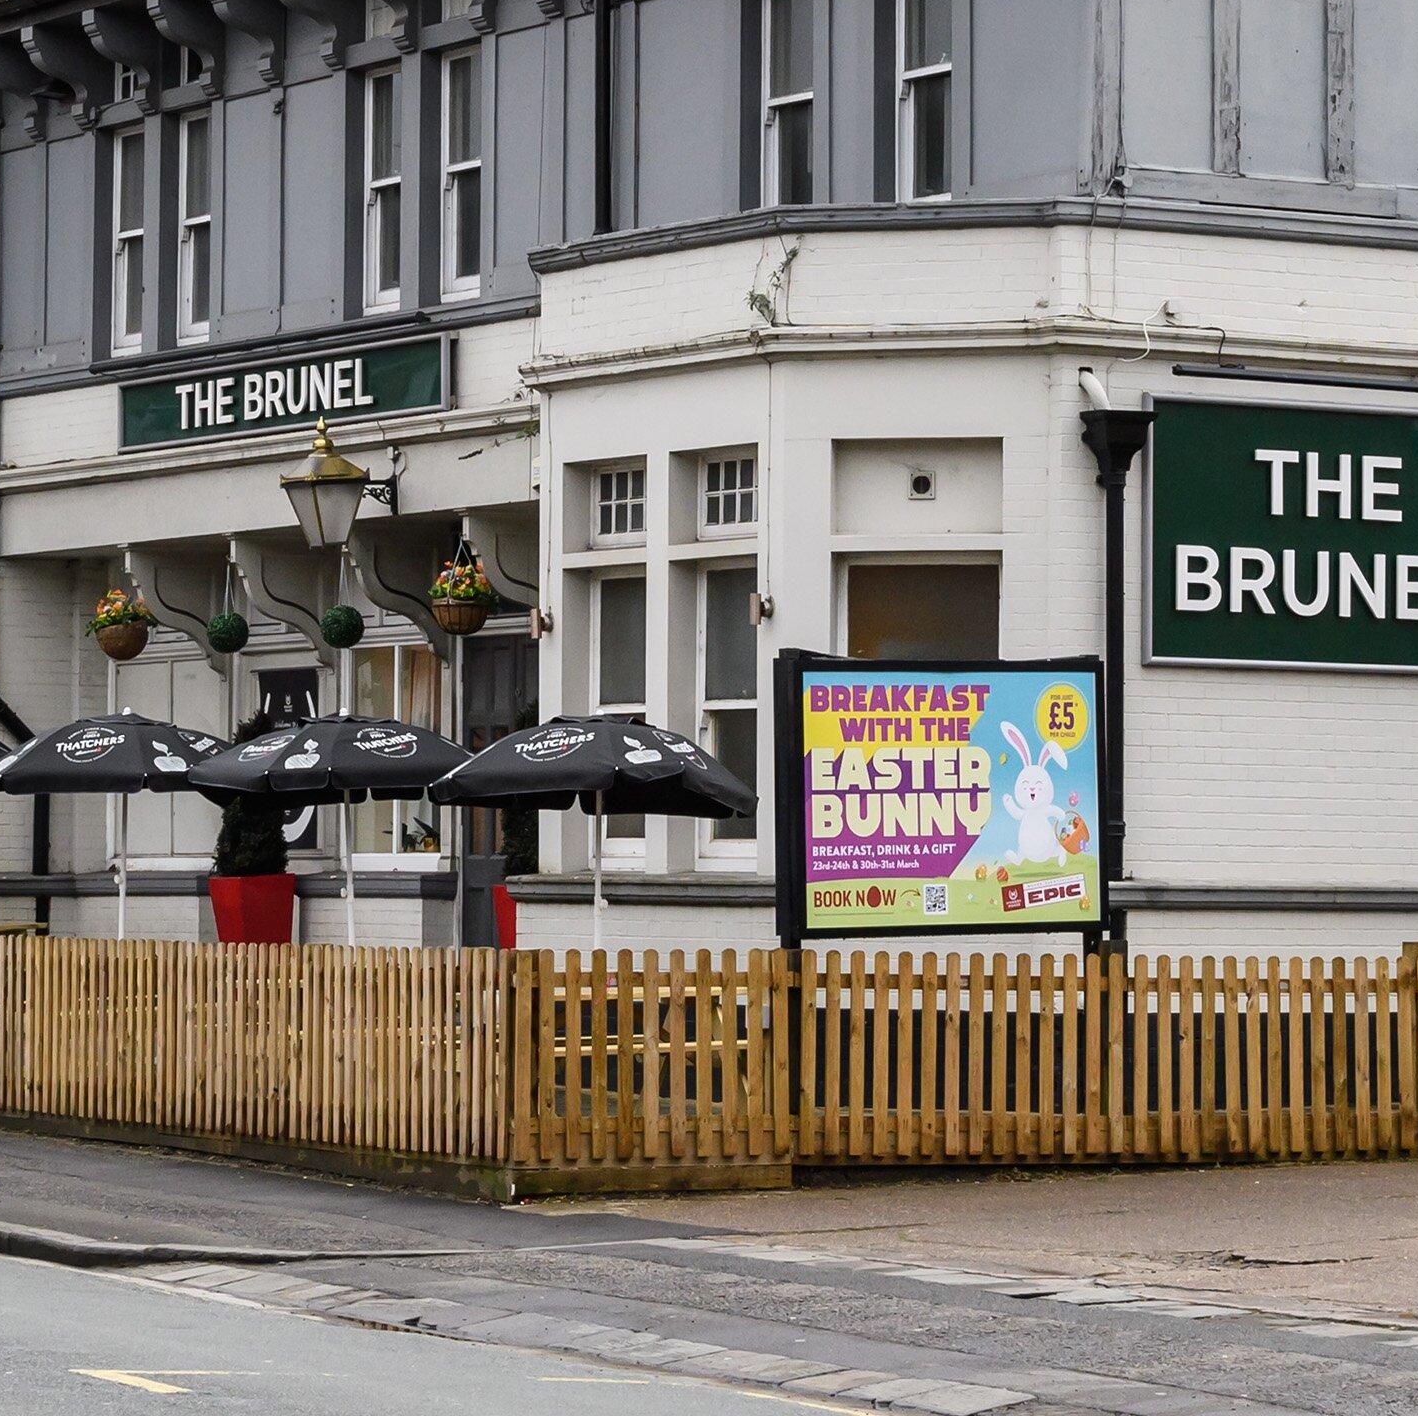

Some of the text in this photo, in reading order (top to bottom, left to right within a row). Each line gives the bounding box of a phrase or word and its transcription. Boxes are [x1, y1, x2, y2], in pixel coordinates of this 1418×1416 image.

[175, 358, 373, 430] THE BRUNEL
[1254, 448, 1403, 522] THE
[809, 684, 991, 712] BREAKFAST
[1049, 701, 1075, 730] £5
[839, 717, 971, 742] WITH THE
[55, 734, 126, 753] THATCHERS
[352, 732, 418, 751] THATCHERS
[514, 732, 595, 754] THATCHERS
[810, 746, 992, 791] EASTER
[811, 792, 992, 838] BUNNY
[812, 844, 875, 857] BREAKFAST,
[877, 844, 911, 856] DRINK
[913, 844, 920, 855] &
[922, 844, 930, 855] A
[812, 859, 920, 871] 23rd-24th & 30th-31st March
[814, 891, 852, 908] BOOK
[1028, 884, 1082, 903] EPIC
